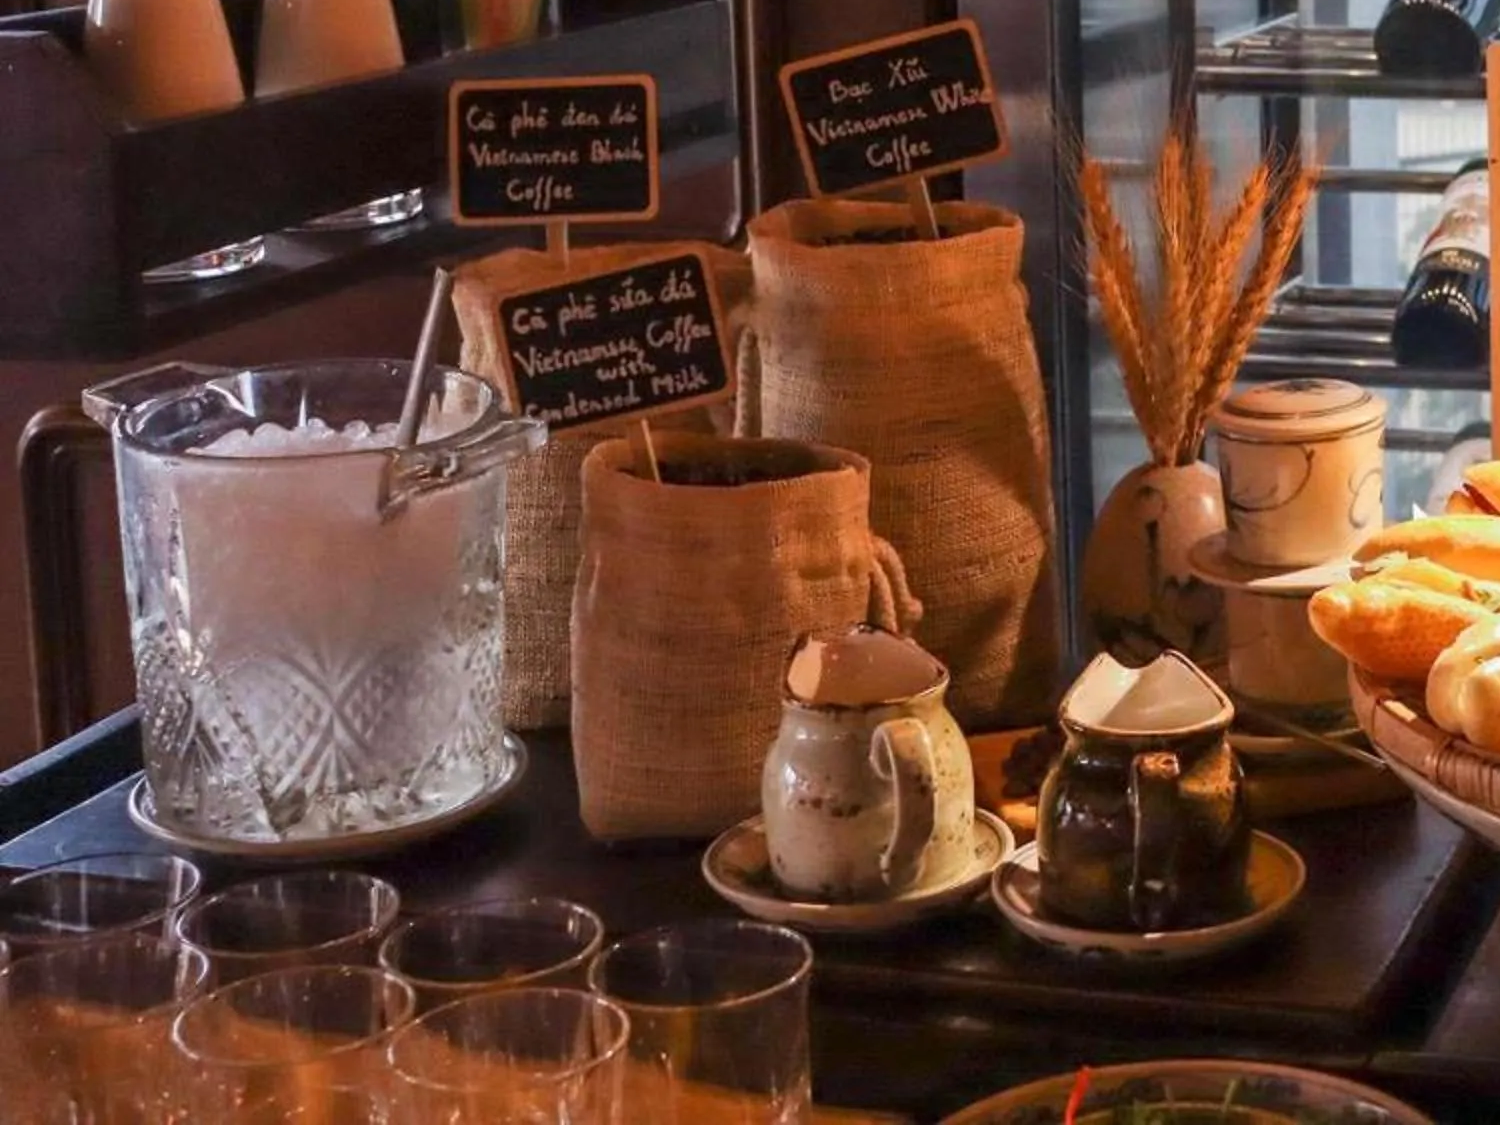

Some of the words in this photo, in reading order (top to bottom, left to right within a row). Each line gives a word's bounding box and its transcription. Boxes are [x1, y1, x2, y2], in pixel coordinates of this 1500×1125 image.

[866, 135, 933, 172] Coffee
[506, 175, 574, 211] Coffee
[595, 350, 657, 382] with
[651, 364, 710, 397] Milk
